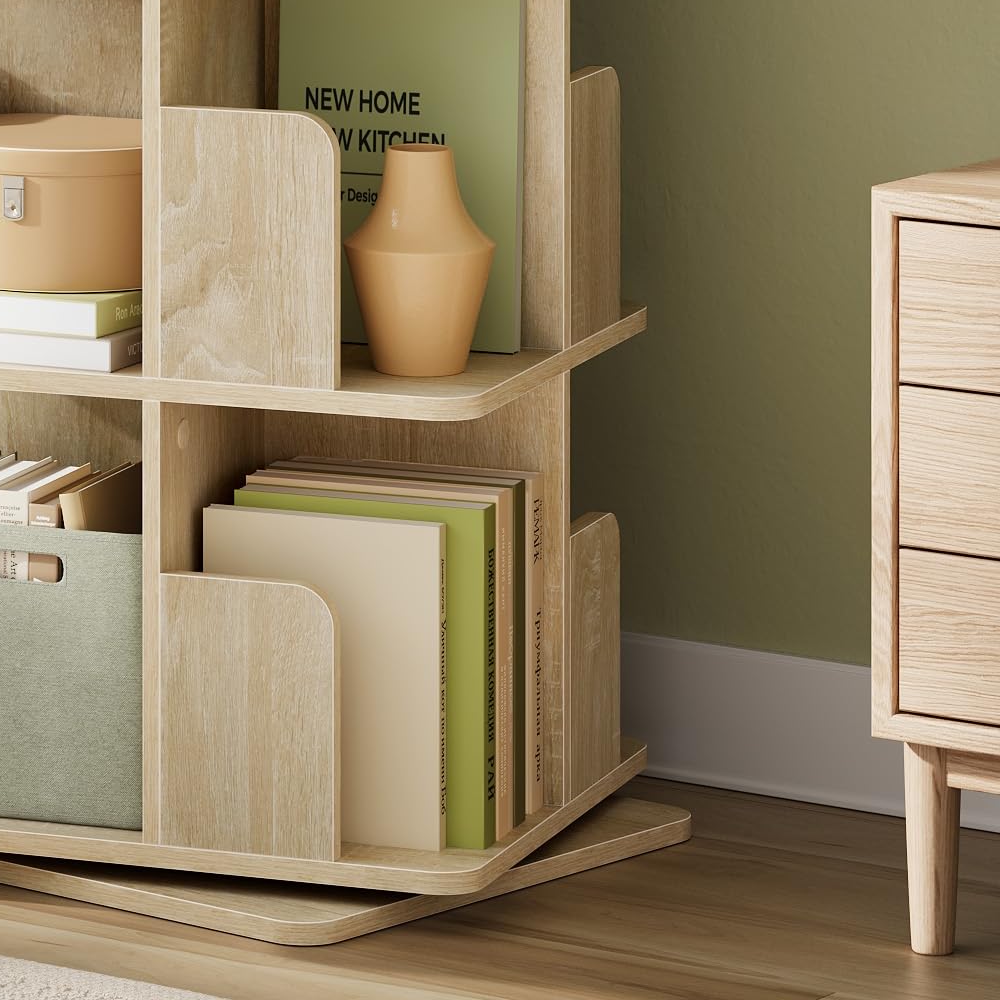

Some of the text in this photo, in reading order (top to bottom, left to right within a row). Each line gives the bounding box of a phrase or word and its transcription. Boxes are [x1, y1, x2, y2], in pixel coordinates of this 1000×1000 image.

[305, 87, 421, 116] NEW HOME
[347, 188, 379, 206] Desig
[129, 303, 142, 317] Ara
[487, 547, 496, 801] БОЖЕСТВЕННАЯ КОМЕДИЯ РАЙ
